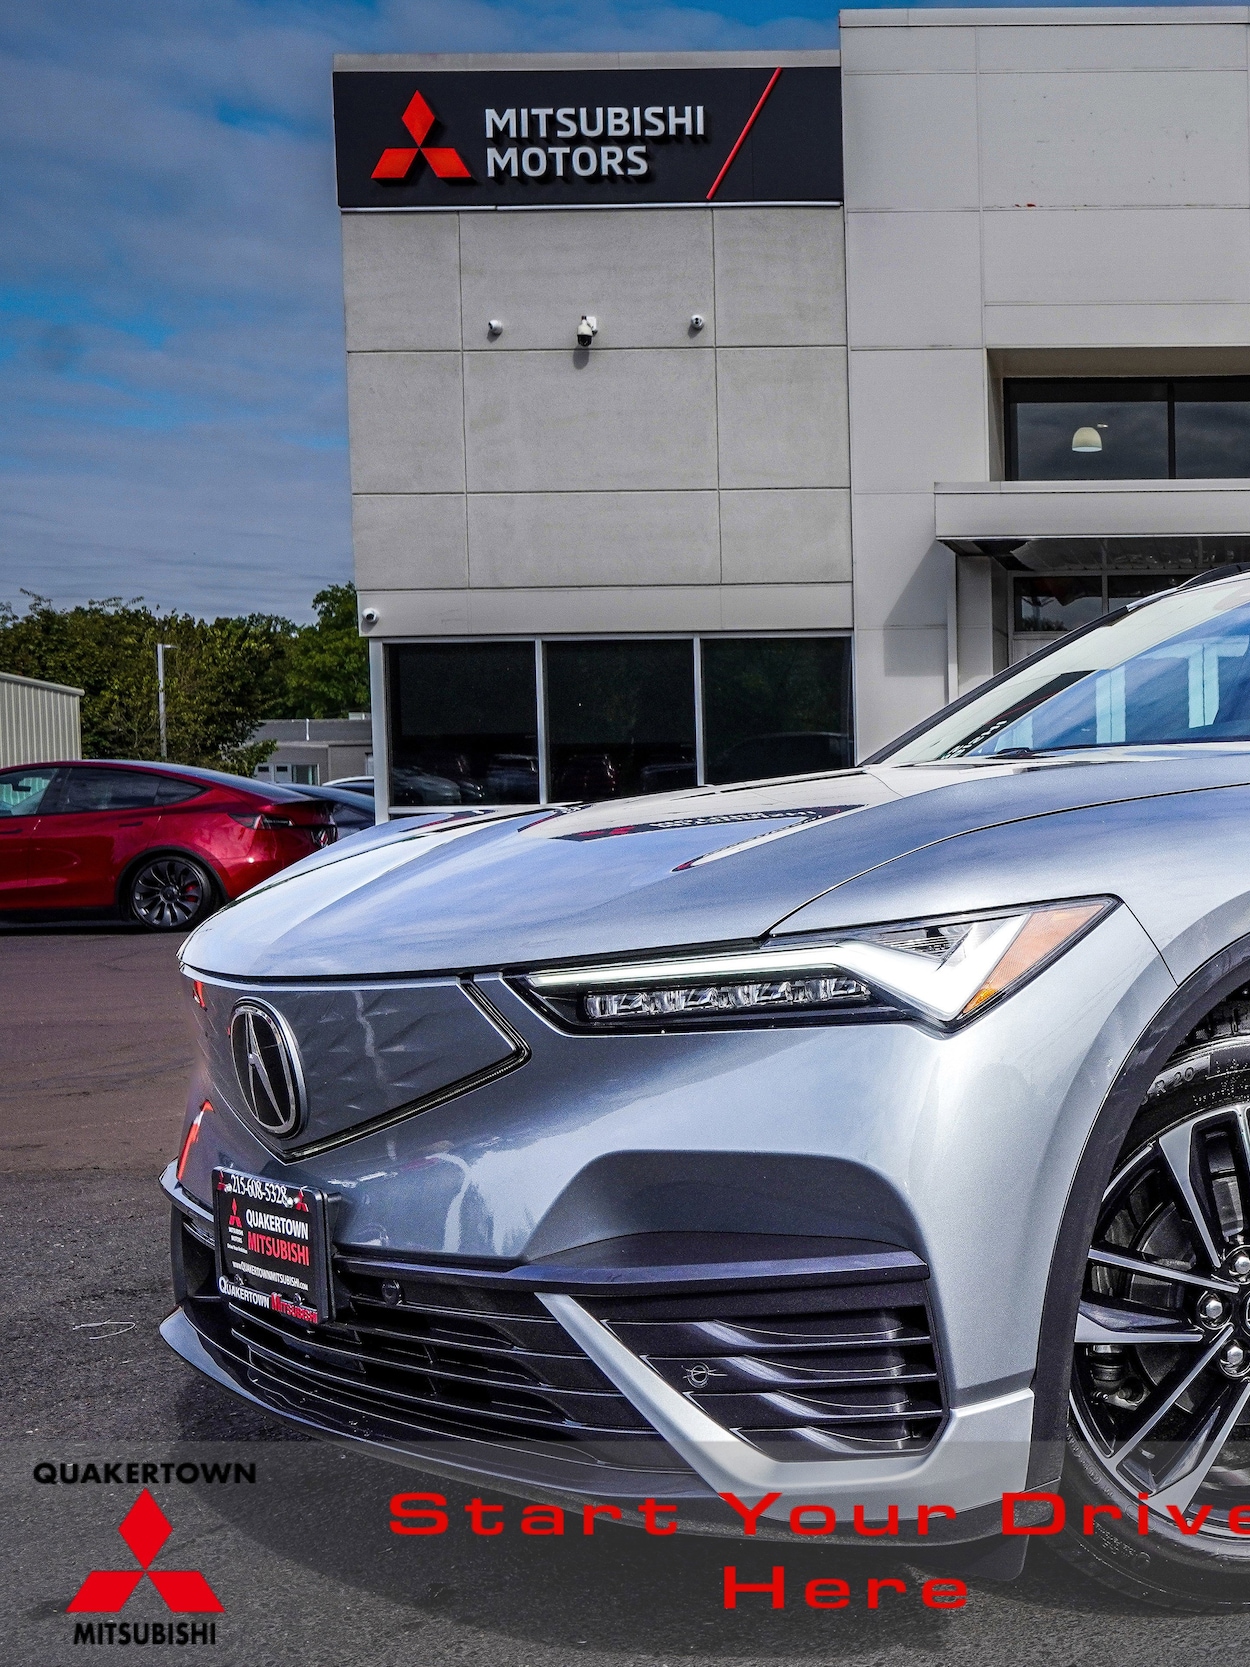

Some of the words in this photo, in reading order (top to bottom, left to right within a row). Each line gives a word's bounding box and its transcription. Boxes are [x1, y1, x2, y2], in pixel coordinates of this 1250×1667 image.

[485, 105, 705, 138] MITSUBISHI
[487, 145, 648, 177] MOTORS
[230, 1174, 289, 1206] 215-608-5328
[245, 1208, 309, 1241] QUAKERTOWN
[247, 1231, 310, 1267] MITSUBISHI
[218, 1275, 270, 1309] QUAKERTOWN
[270, 1291, 318, 1324] MITSUBISHI
